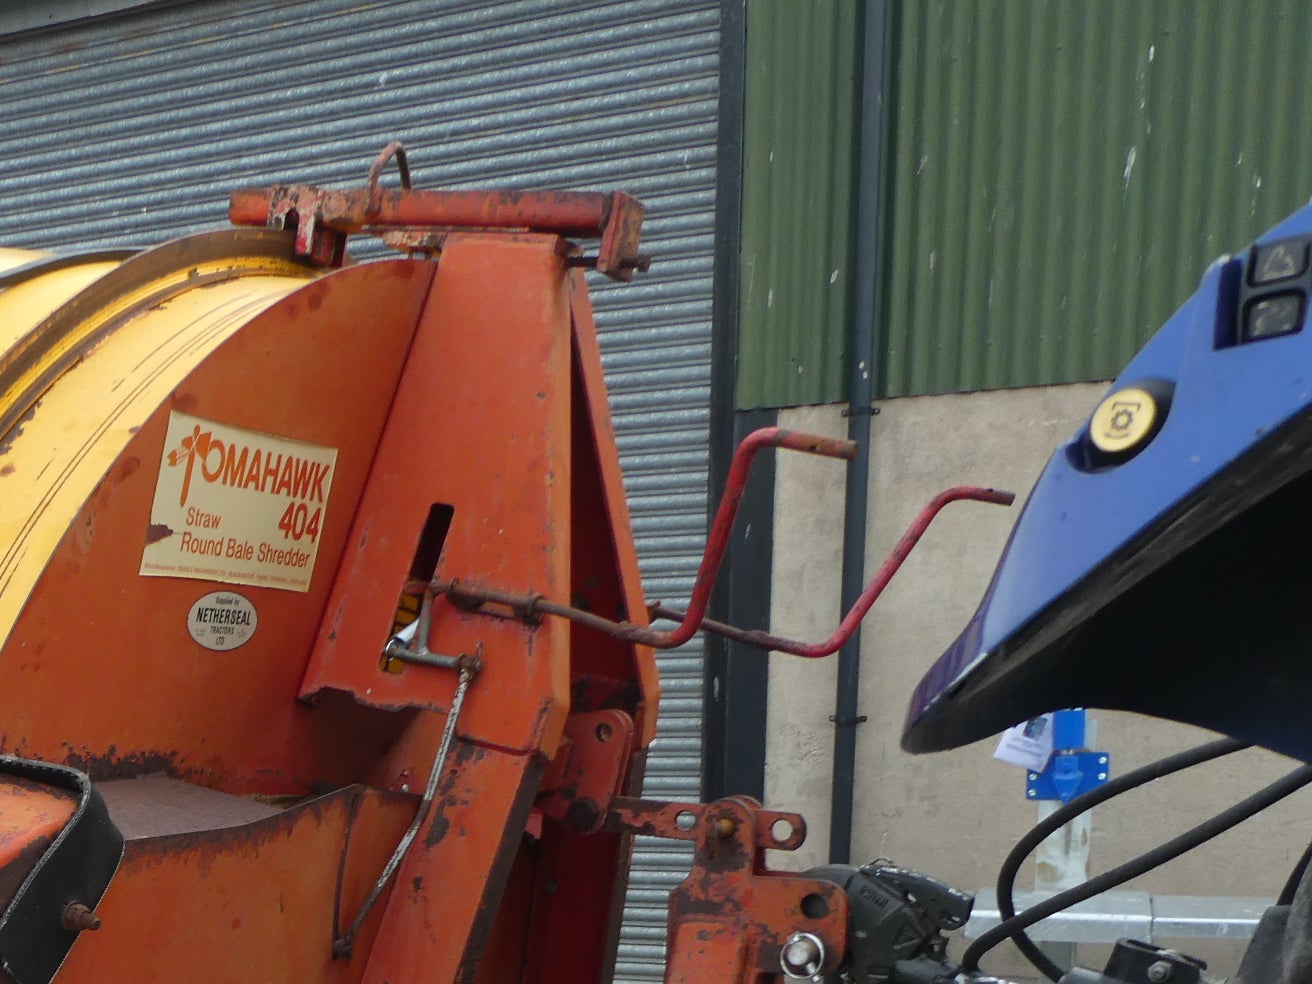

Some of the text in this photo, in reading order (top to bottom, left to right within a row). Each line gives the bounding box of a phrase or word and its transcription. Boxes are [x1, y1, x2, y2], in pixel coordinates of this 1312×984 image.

[168, 425, 330, 507] TOMAHAWK
[186, 506, 222, 529] Straw
[278, 502, 321, 543] 404
[181, 531, 310, 568] Round Bale Shredder
[196, 607, 251, 625] NETHERSEAL
[210, 626, 235, 635] TRACTORS
[215, 636, 225, 645] LTD
